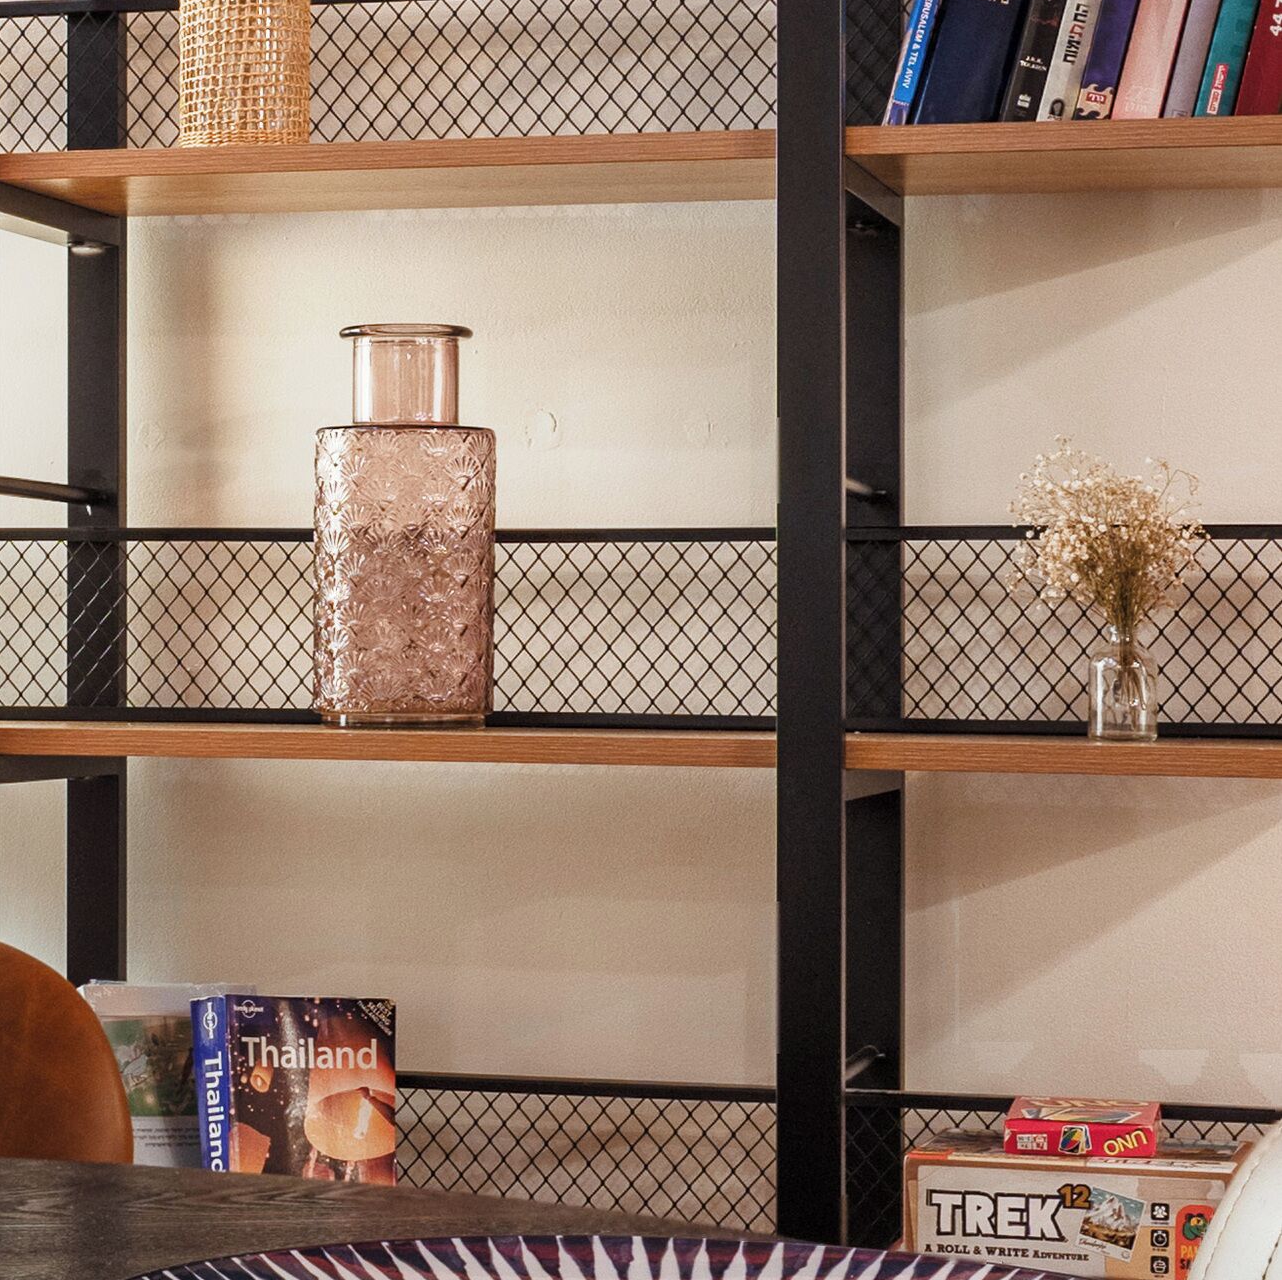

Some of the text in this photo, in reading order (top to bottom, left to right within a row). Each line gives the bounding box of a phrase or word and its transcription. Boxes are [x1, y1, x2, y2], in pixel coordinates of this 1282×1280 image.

[1062, 2, 1088, 64] החתימות
[907, 51, 918, 67] TEL
[902, 67, 912, 89] AVIV
[367, 1002, 391, 1025] SELLING
[376, 1002, 392, 1017] BEST
[241, 1036, 378, 1070] Thailand
[1103, 1130, 1148, 1156] UNO
[926, 1189, 1068, 1243] TREK
[1057, 1183, 1093, 1209] 12
[924, 1244, 932, 1253] A
[936, 1244, 970, 1255] ROLL
[973, 1245, 982, 1256] &
[985, 1246, 1029, 1259] WRITE
